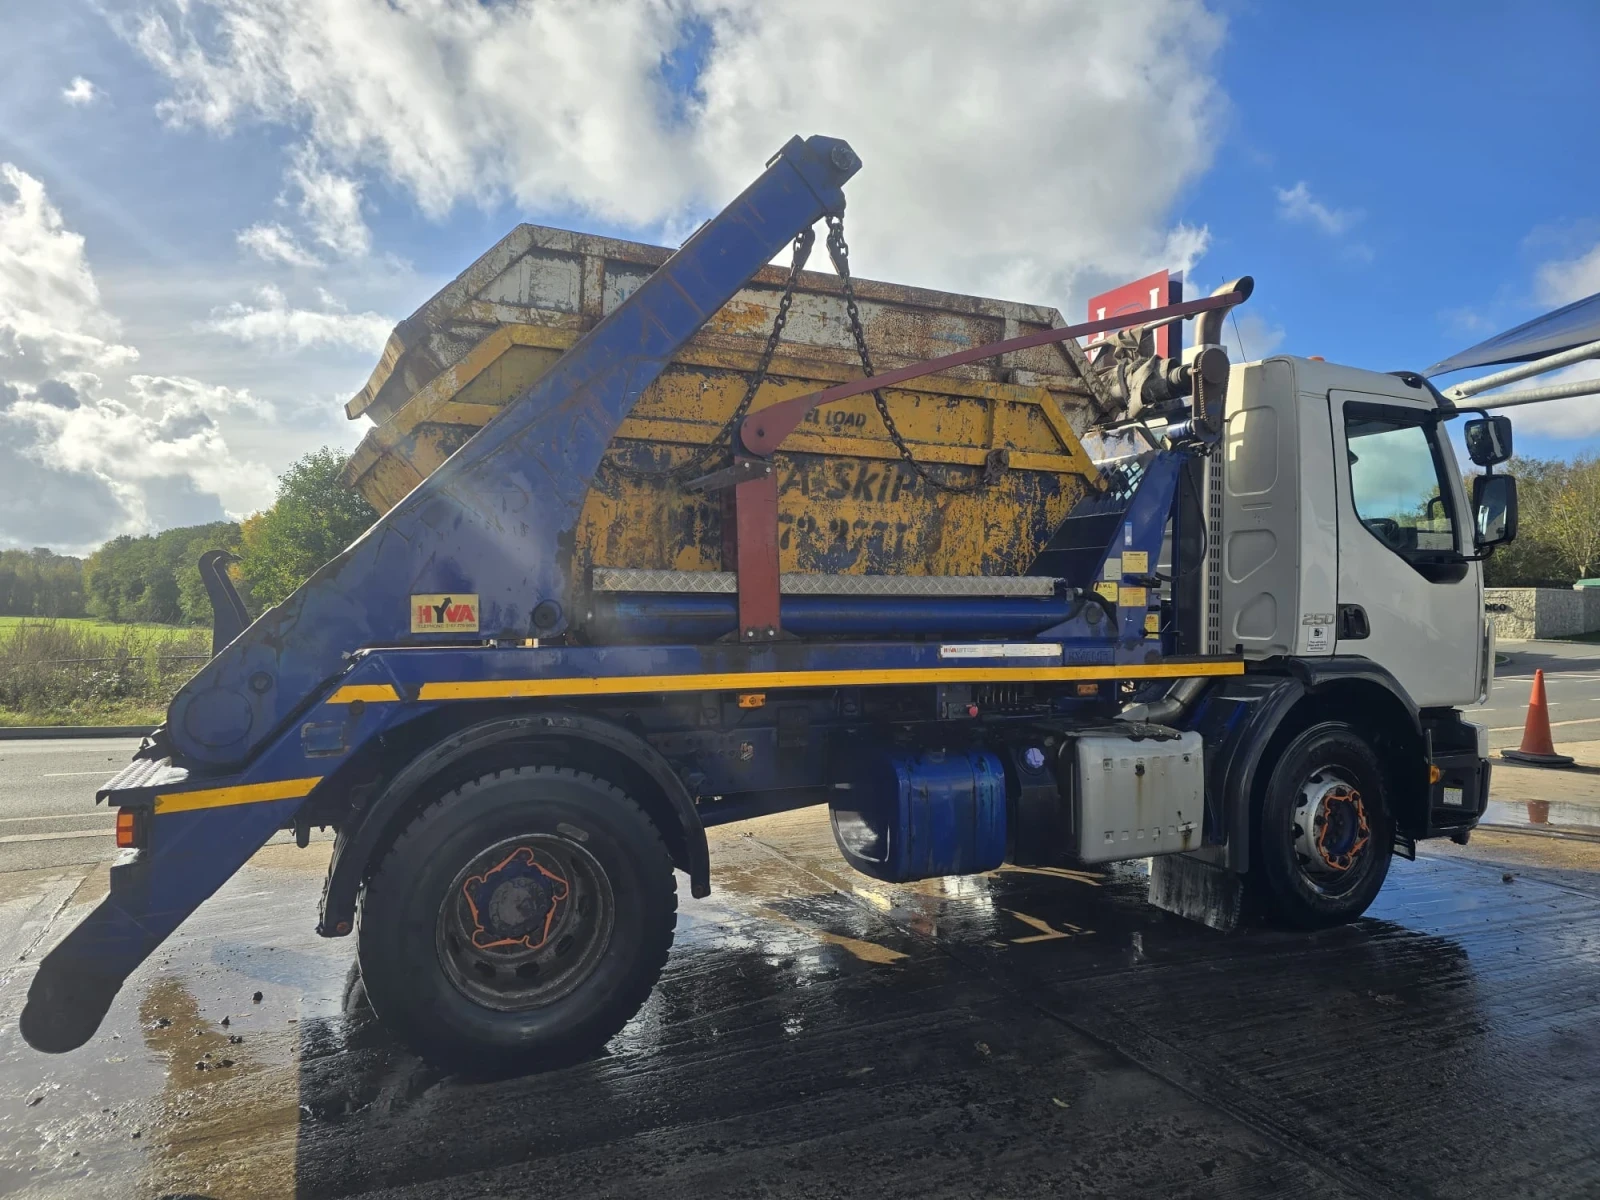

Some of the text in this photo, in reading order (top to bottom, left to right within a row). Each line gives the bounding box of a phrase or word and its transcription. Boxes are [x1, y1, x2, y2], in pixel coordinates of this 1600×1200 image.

[825, 410, 867, 428] LOAD
[416, 596, 476, 623] HYVA
[1302, 613, 1335, 625] 250
